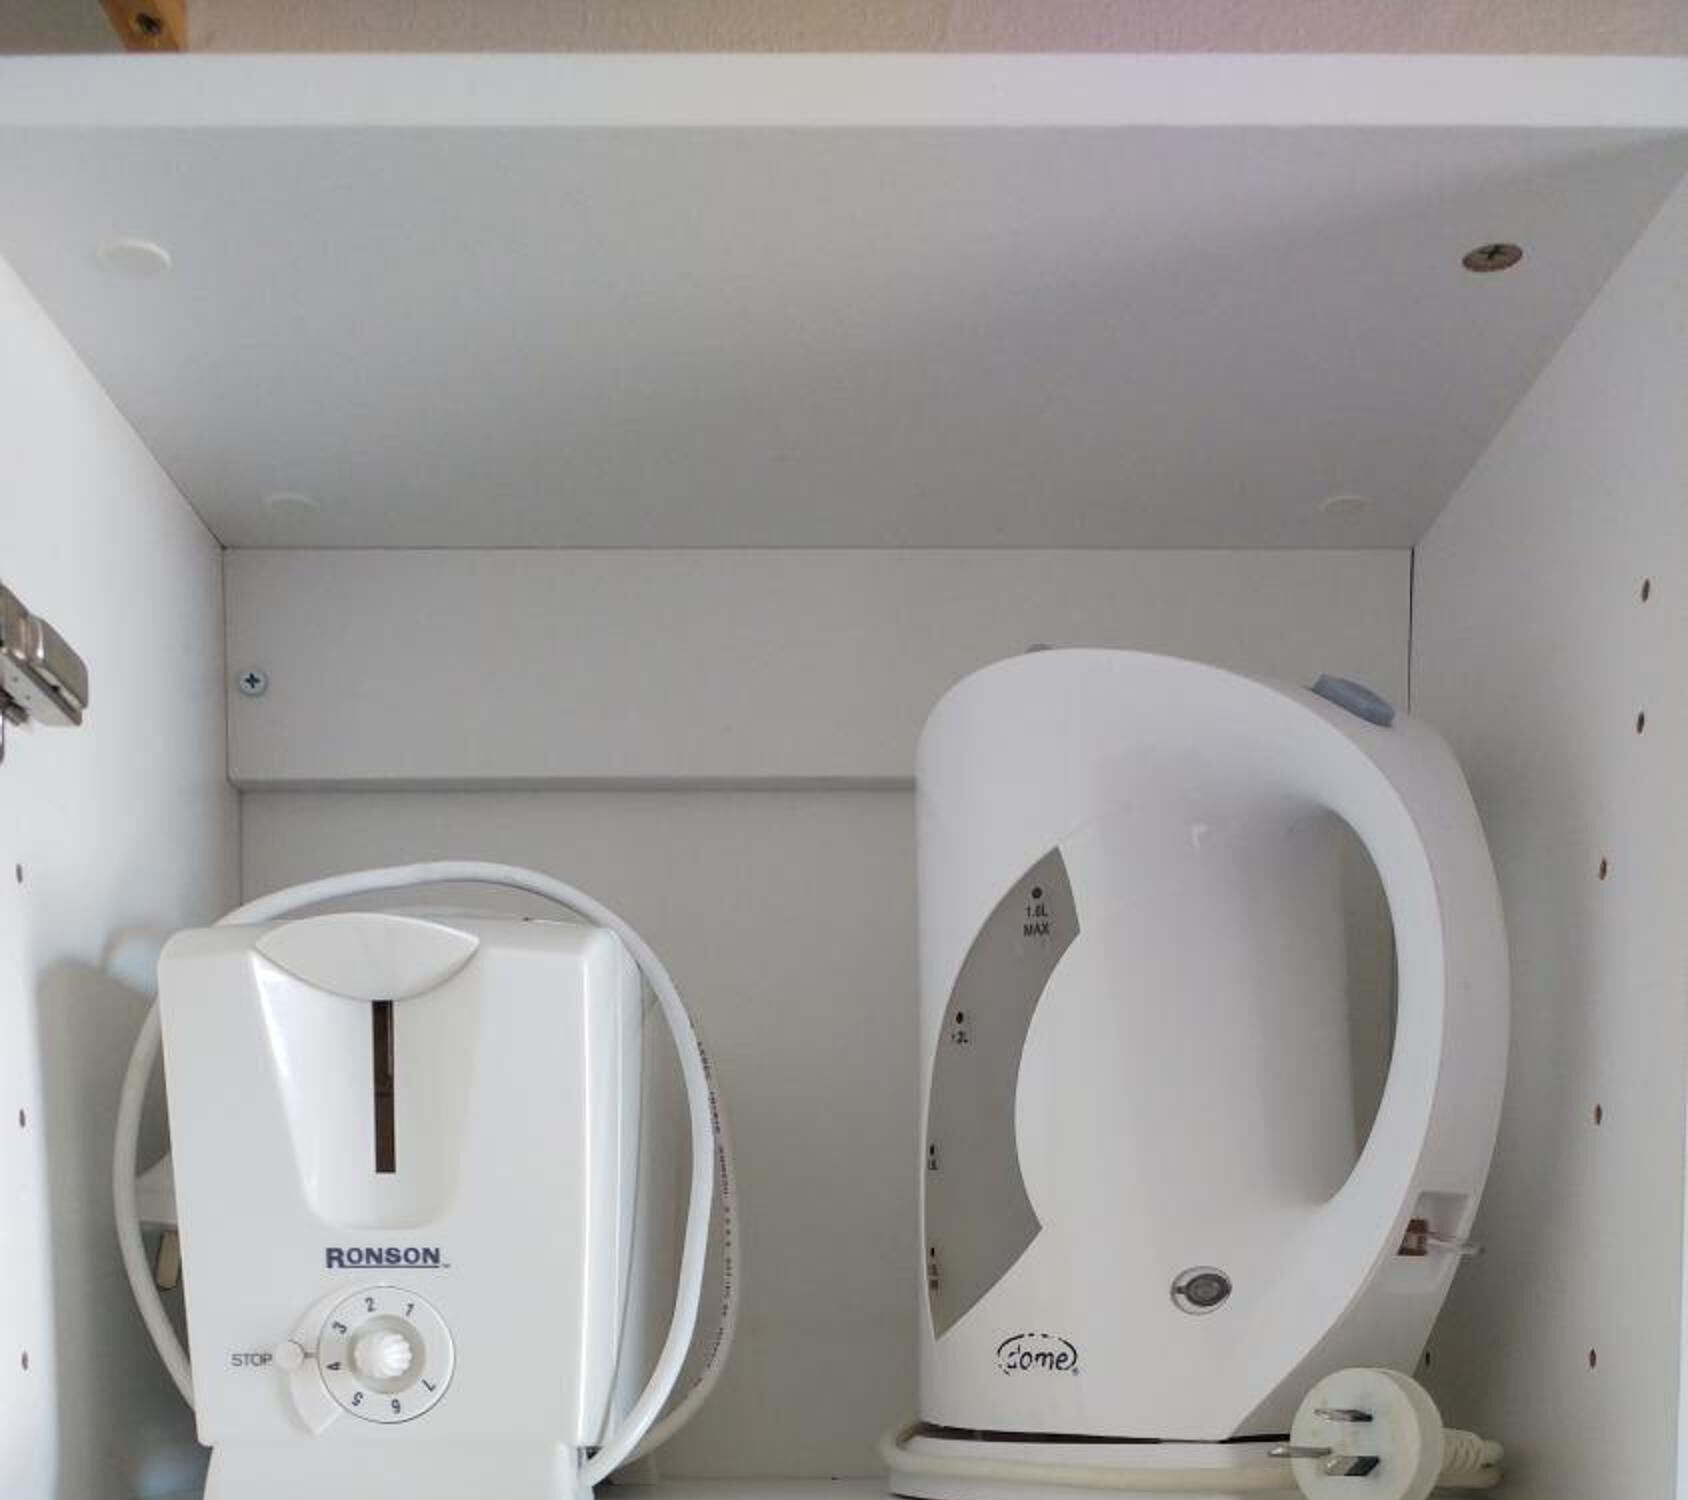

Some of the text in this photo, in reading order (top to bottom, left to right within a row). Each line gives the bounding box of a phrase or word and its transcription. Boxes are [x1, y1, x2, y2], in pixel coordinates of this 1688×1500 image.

[1023, 921, 1051, 938] MAX
[325, 1247, 441, 1268] RONSON
[365, 1297, 376, 1312] 2
[404, 1303, 415, 1316] 1
[332, 1320, 347, 1334] 3
[231, 1353, 273, 1367] STOP
[326, 1361, 341, 1371] 4
[391, 1399, 401, 1414] 6
